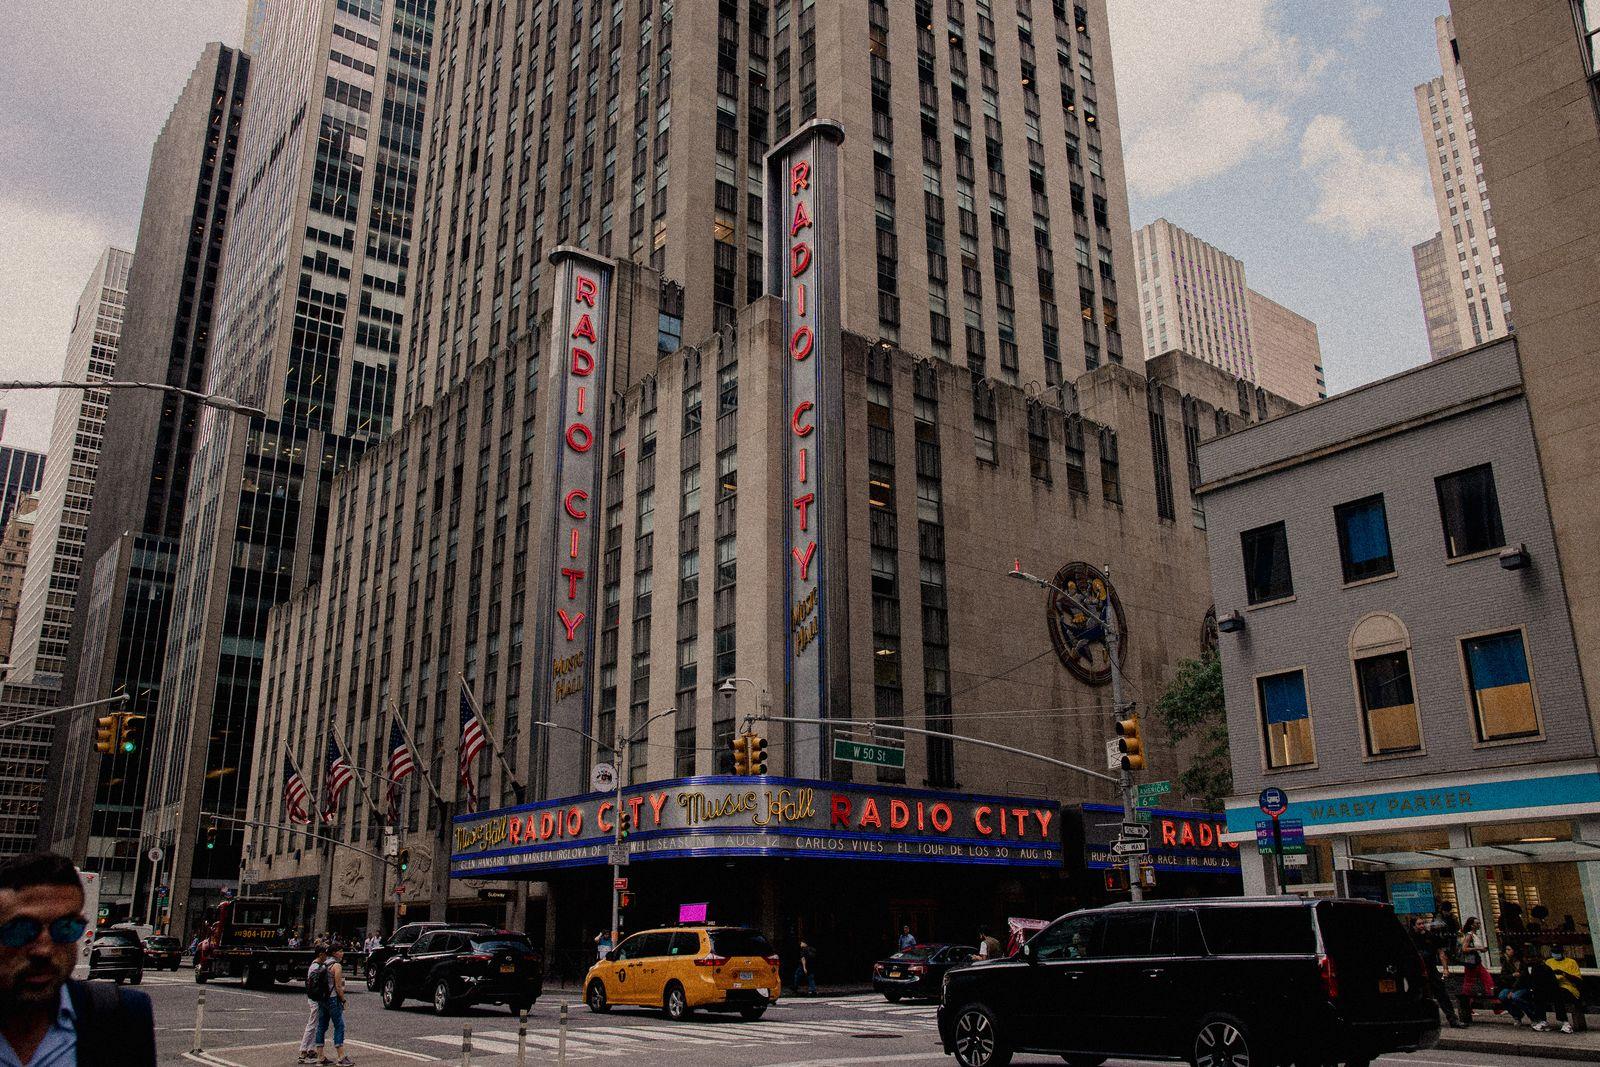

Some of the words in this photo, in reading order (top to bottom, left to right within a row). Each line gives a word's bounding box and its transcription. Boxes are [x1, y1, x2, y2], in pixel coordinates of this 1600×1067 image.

[790, 161, 814, 361] RADIO
[565, 275, 597, 453] RADIO
[791, 400, 818, 581] CITY
[558, 489, 589, 641] CITY
[853, 746, 861, 758] W
[863, 748, 874, 760] 50
[877, 749, 887, 762] St
[676, 790, 758, 827] Music
[752, 787, 817, 827] Hall
[831, 792, 954, 834] RADIO
[974, 805, 1053, 839] CITY
[1308, 799, 1377, 820] WARBY
[1387, 790, 1474, 813] PARKER
[508, 807, 584, 845] RADIO
[725, 834, 756, 847] AUG
[508, 854, 520, 865] AND
[523, 850, 554, 864] MARKETA
[796, 836, 845, 851] CARLOS
[851, 840, 885, 852] VIVES
[897, 842, 911, 853] EL
[918, 844, 945, 855] TOUR
[950, 846, 964, 856] DE
[969, 847, 989, 858] LOS
[995, 848, 1009, 858] 30
[1020, 849, 1039, 859] AUG
[1157, 854, 1178, 865] RACE
[1203, 857, 1217, 867] AUG
[1221, 858, 1231, 868] 25
